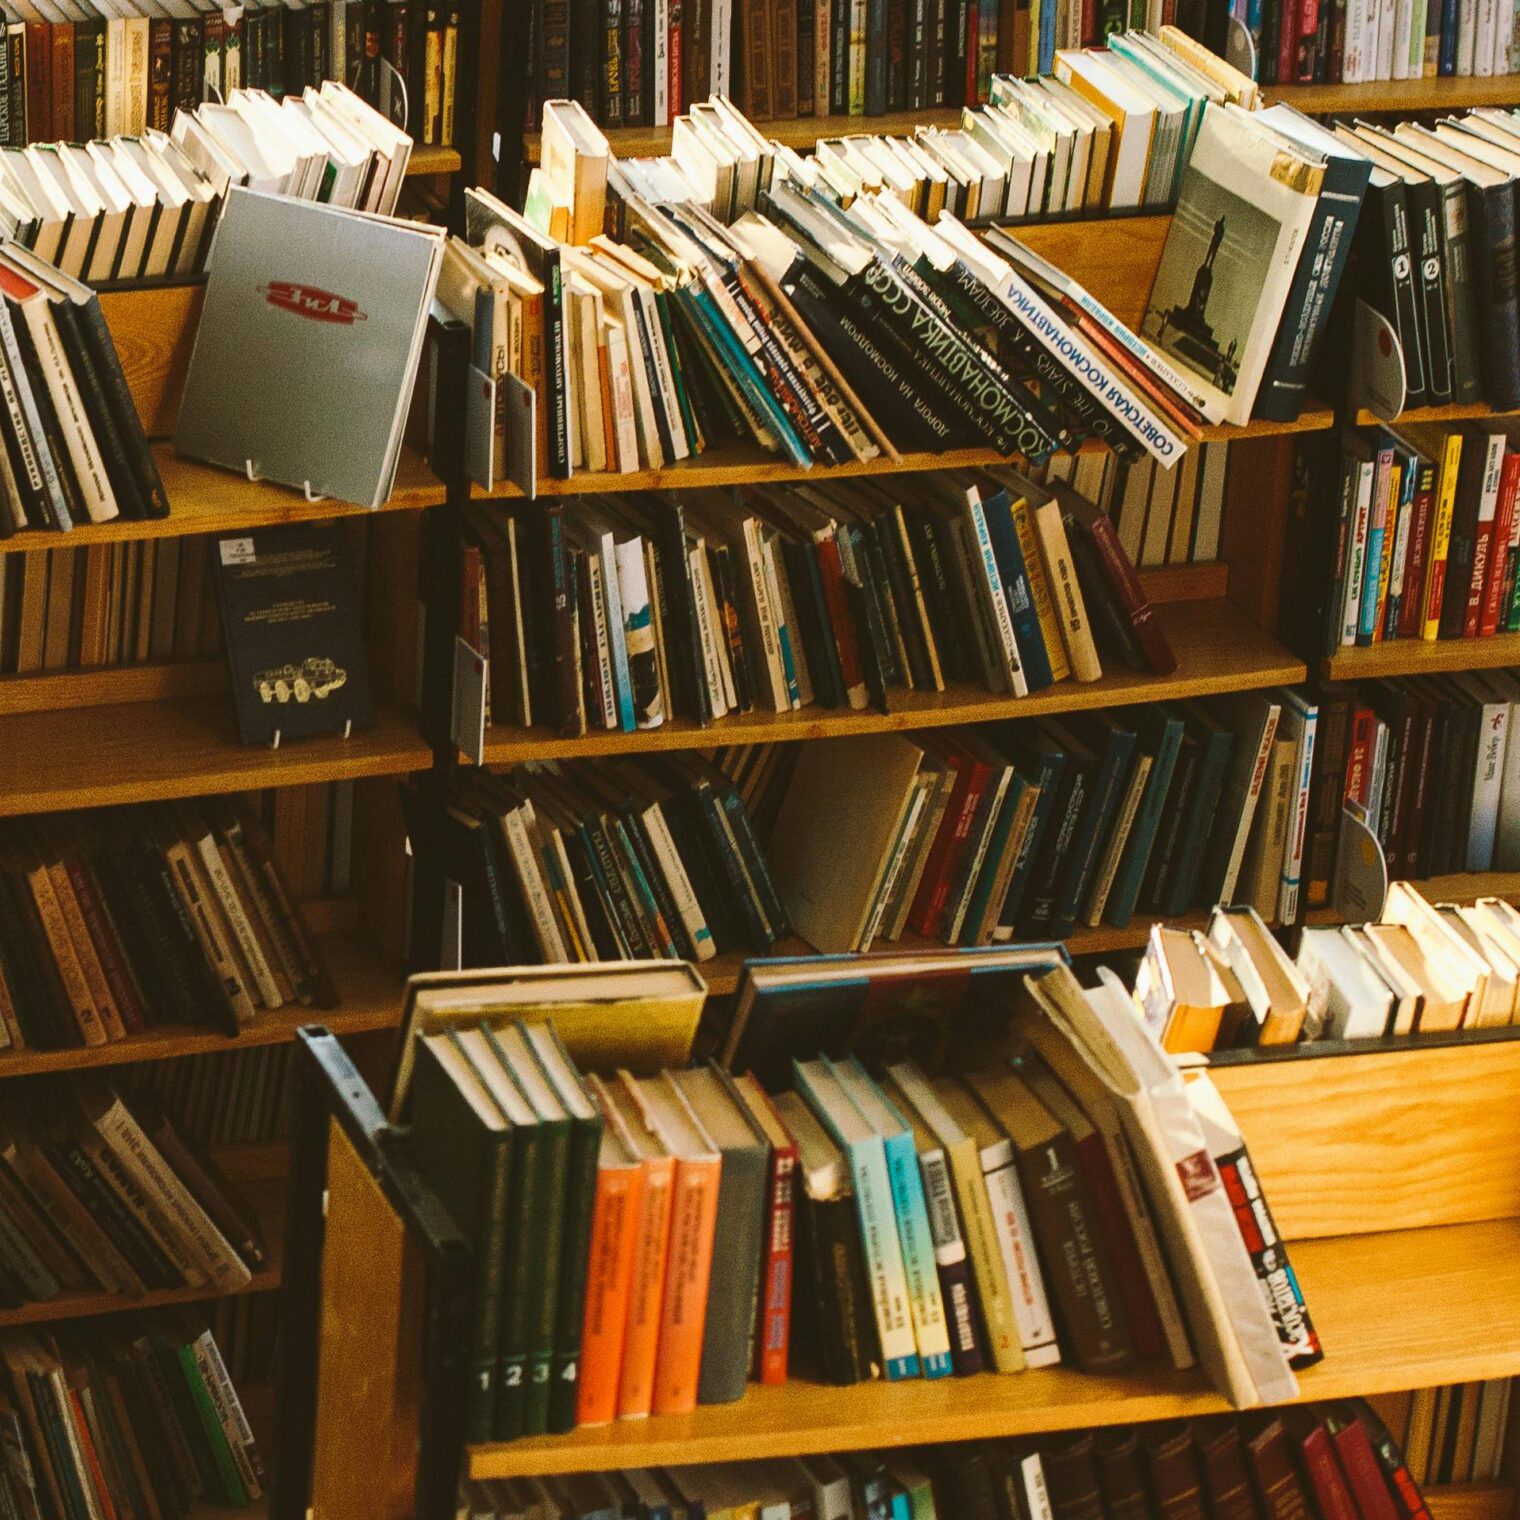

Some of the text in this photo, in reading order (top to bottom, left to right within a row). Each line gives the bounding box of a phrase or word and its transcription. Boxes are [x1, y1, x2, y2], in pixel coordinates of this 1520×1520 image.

[0, 94, 10, 142] ЦАРСКОЕ
[957, 272, 1017, 328] ЗВЕЗДАМ
[1114, 325, 1147, 356] ИСТОРИЯ
[839, 316, 950, 437] ДОРОГА НА КОСМОДРОМ
[865, 262, 1050, 459] КОСМОНАВТИКА СССР
[1007, 284, 1174, 456] СОВЕТСКАЯ КОСМОНАВТИКА
[1036, 353, 1074, 394] STARS
[554, 321, 565, 463] СПОРТИВНЫЕ АВТОМОБИЛИ
[1073, 392, 1094, 416] THE
[1356, 506, 1367, 544] АРТРИТ
[1413, 496, 1429, 567] ДЕЛО СЕРДЦА
[984, 549, 1000, 592] ИСТОРИЯ
[1469, 533, 1489, 606] В. ДИКУЛЬ
[556, 593, 566, 610] 15
[1070, 618, 1081, 633] 15
[225, 976, 241, 997] 3
[80, 1008, 93, 1025] 2
[100, 1005, 112, 1021] 1
[1068, 1201, 1091, 1253] РОССИИ
[480, 1372, 490, 1390] 1
[506, 1365, 522, 1386] 2
[532, 1363, 549, 1383] 3
[562, 1362, 576, 1381] 4
